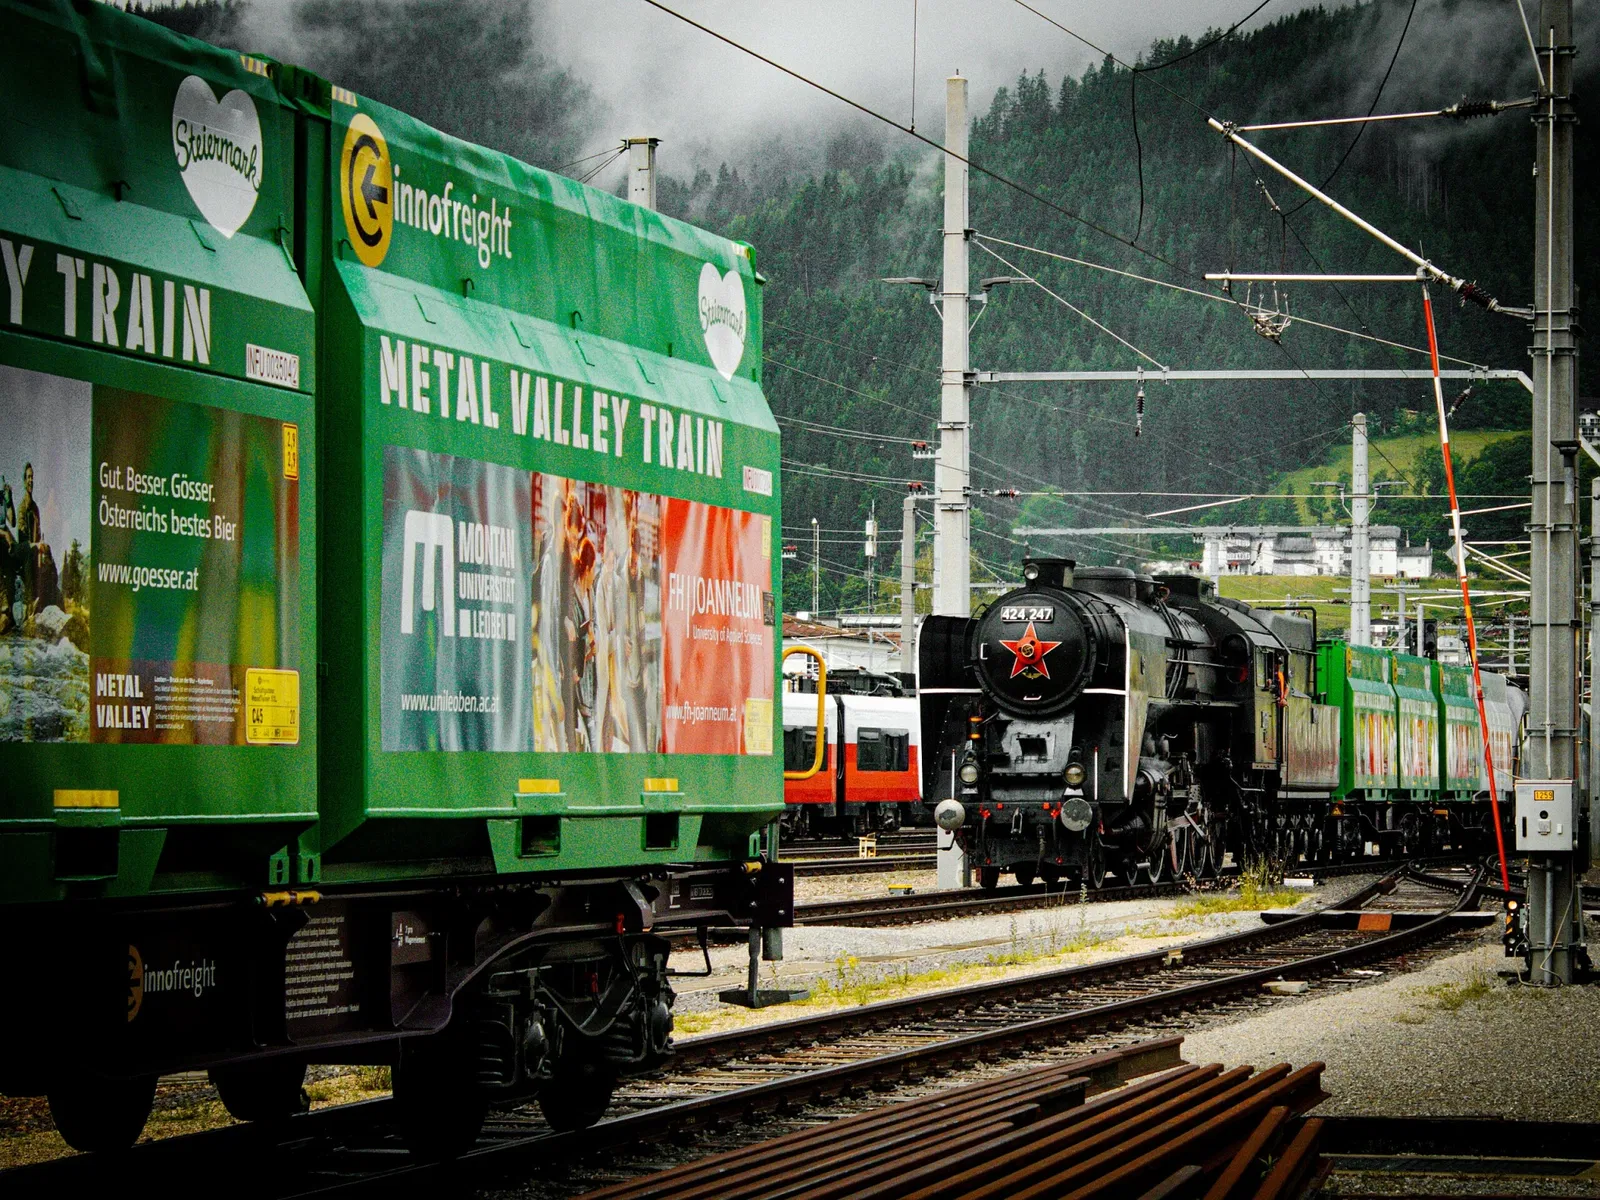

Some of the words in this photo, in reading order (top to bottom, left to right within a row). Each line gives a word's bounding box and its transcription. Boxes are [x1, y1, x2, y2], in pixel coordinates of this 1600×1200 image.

[174, 119, 261, 193] Steiermark
[393, 164, 512, 269] innofreight
[56, 253, 210, 364] TRAIN
[701, 296, 745, 345] Steiermark
[380, 336, 499, 429] METAL
[510, 369, 630, 457] VALLEY
[639, 403, 723, 478] TRAIN
[100, 462, 124, 491] Gut.
[127, 467, 169, 498] Besser.
[171, 473, 216, 503] Gösser.
[100, 495, 168, 533] Österreichs
[171, 505, 212, 536] bestes
[214, 515, 237, 541] Bier
[458, 521, 515, 569] MONTAN
[98, 562, 199, 592] www.goesser.at
[458, 570, 516, 604] UNIVERSITÄT
[669, 572, 684, 611] FH
[691, 576, 761, 620] JOANNEUM
[473, 612, 508, 641] LEOBEN
[96, 673, 144, 698] METAL
[401, 692, 499, 715] www.unileoben.ac.at
[96, 704, 152, 729] VALLEY
[666, 701, 737, 725] www.fh-joanneum.at
[143, 959, 216, 998] innofreight
